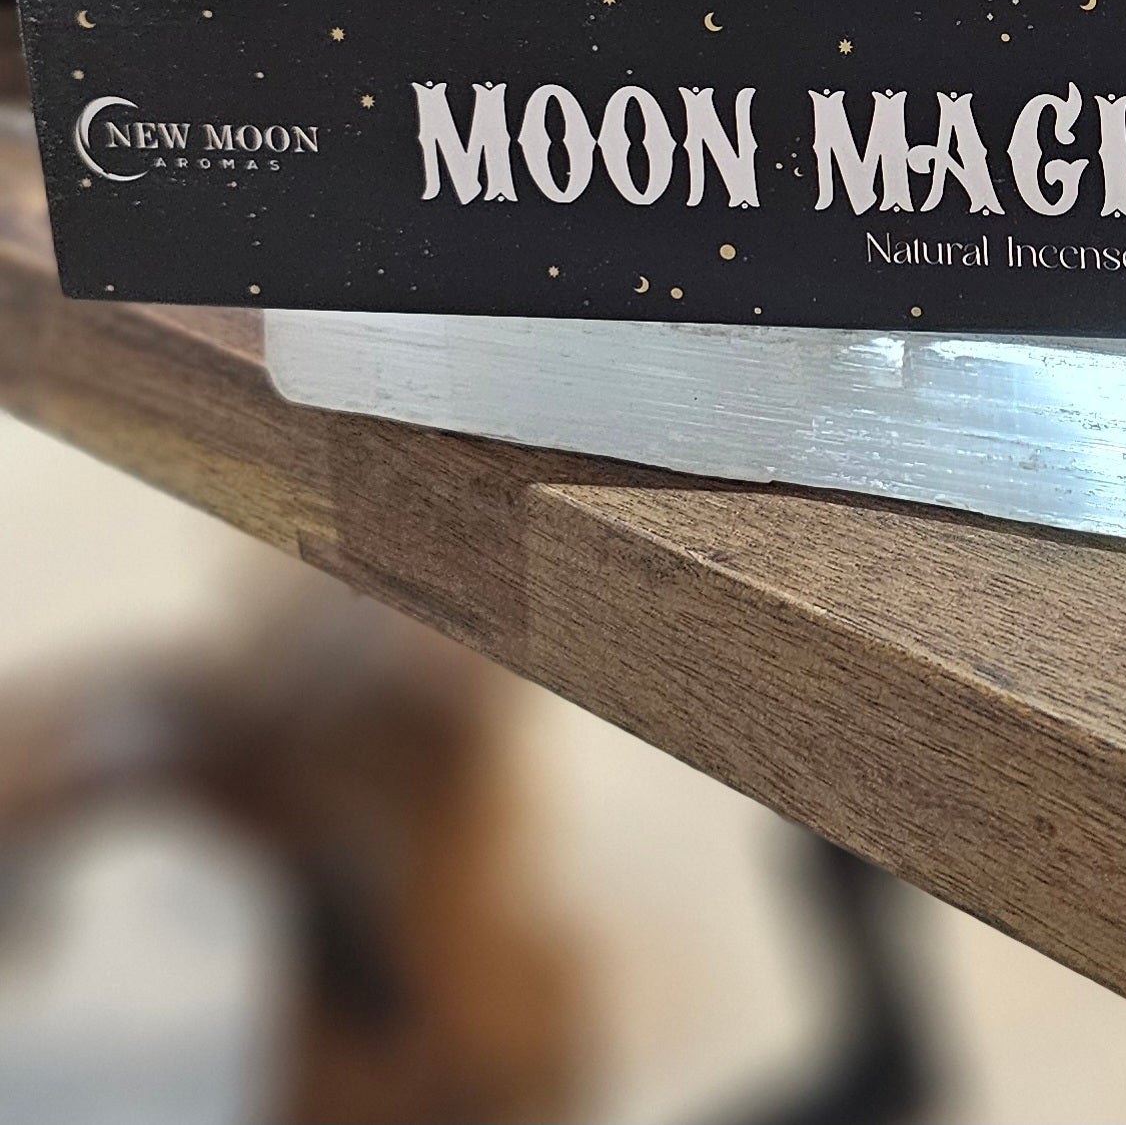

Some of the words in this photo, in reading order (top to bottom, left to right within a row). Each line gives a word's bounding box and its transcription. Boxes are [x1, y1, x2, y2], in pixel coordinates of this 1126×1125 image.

[105, 122, 191, 150] NEW
[203, 124, 319, 153] MOON
[413, 81, 758, 210] MOON
[154, 157, 280, 172] AROMAS
[866, 232, 990, 267] Natural
